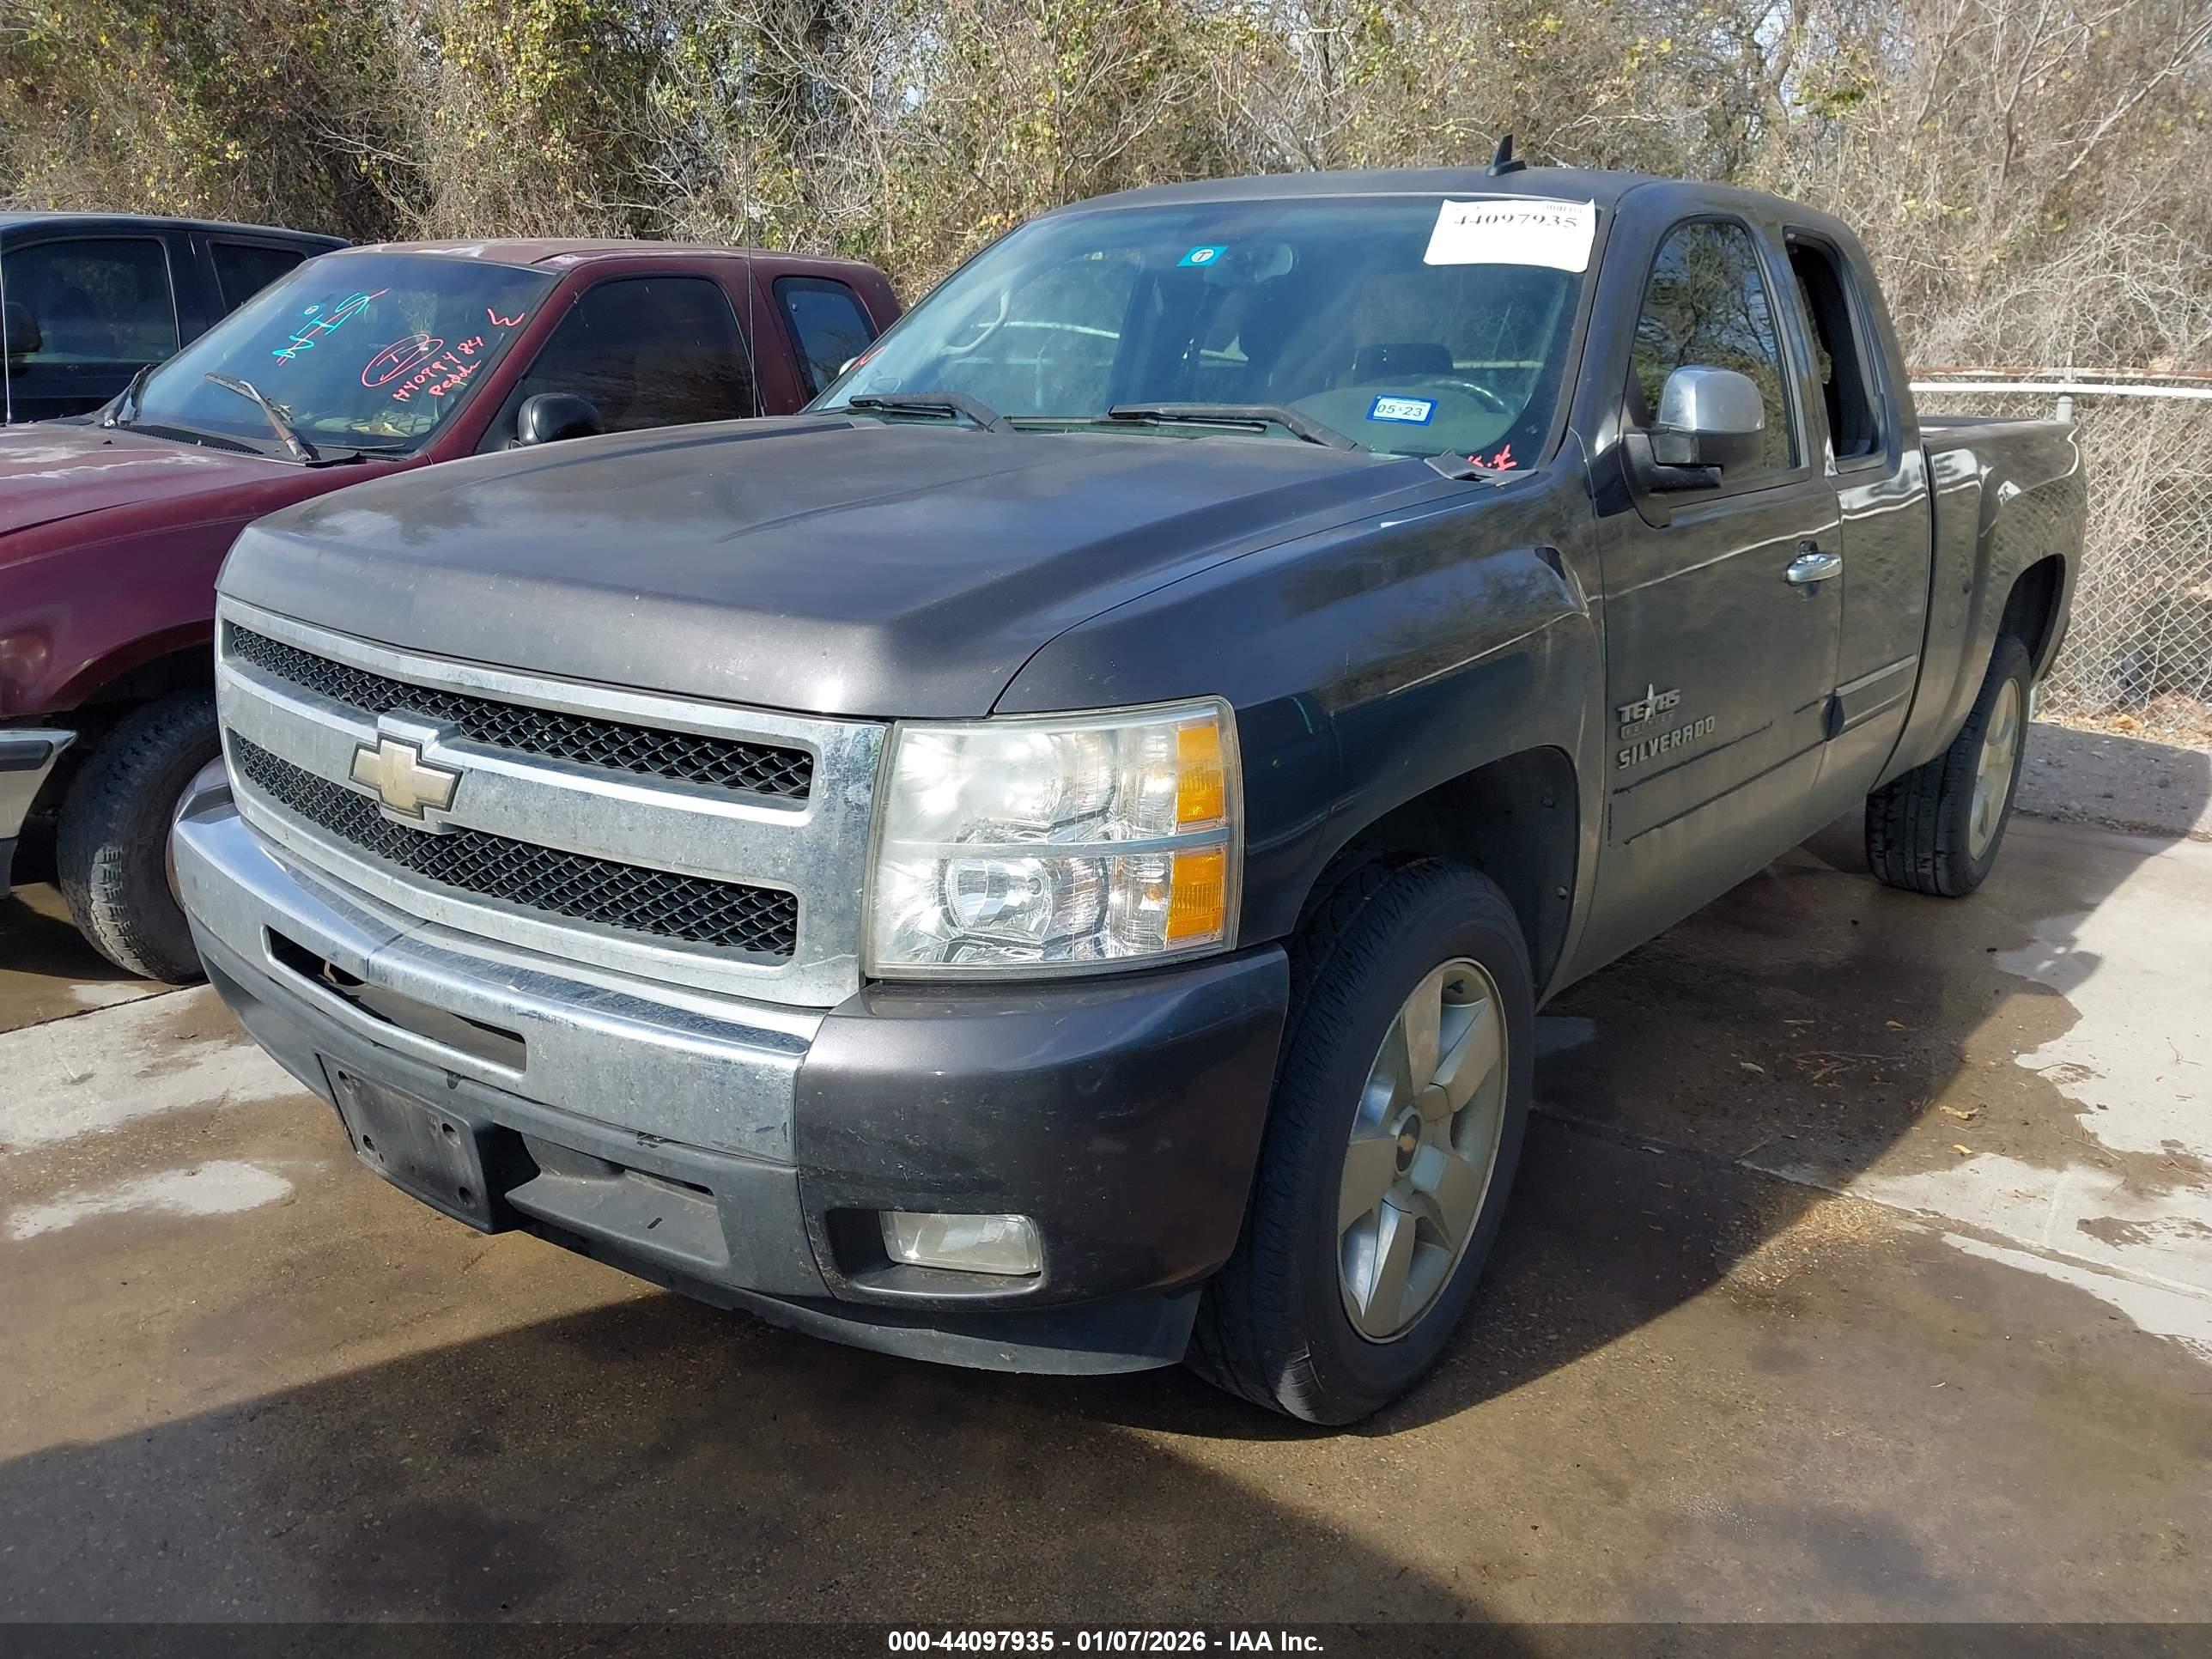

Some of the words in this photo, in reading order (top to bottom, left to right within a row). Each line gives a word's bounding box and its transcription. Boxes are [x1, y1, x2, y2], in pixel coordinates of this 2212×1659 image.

[1453, 213, 1578, 228] 44097935
[1618, 687, 1681, 723] TEXAS
[1618, 714, 1717, 770] SILVERADO
